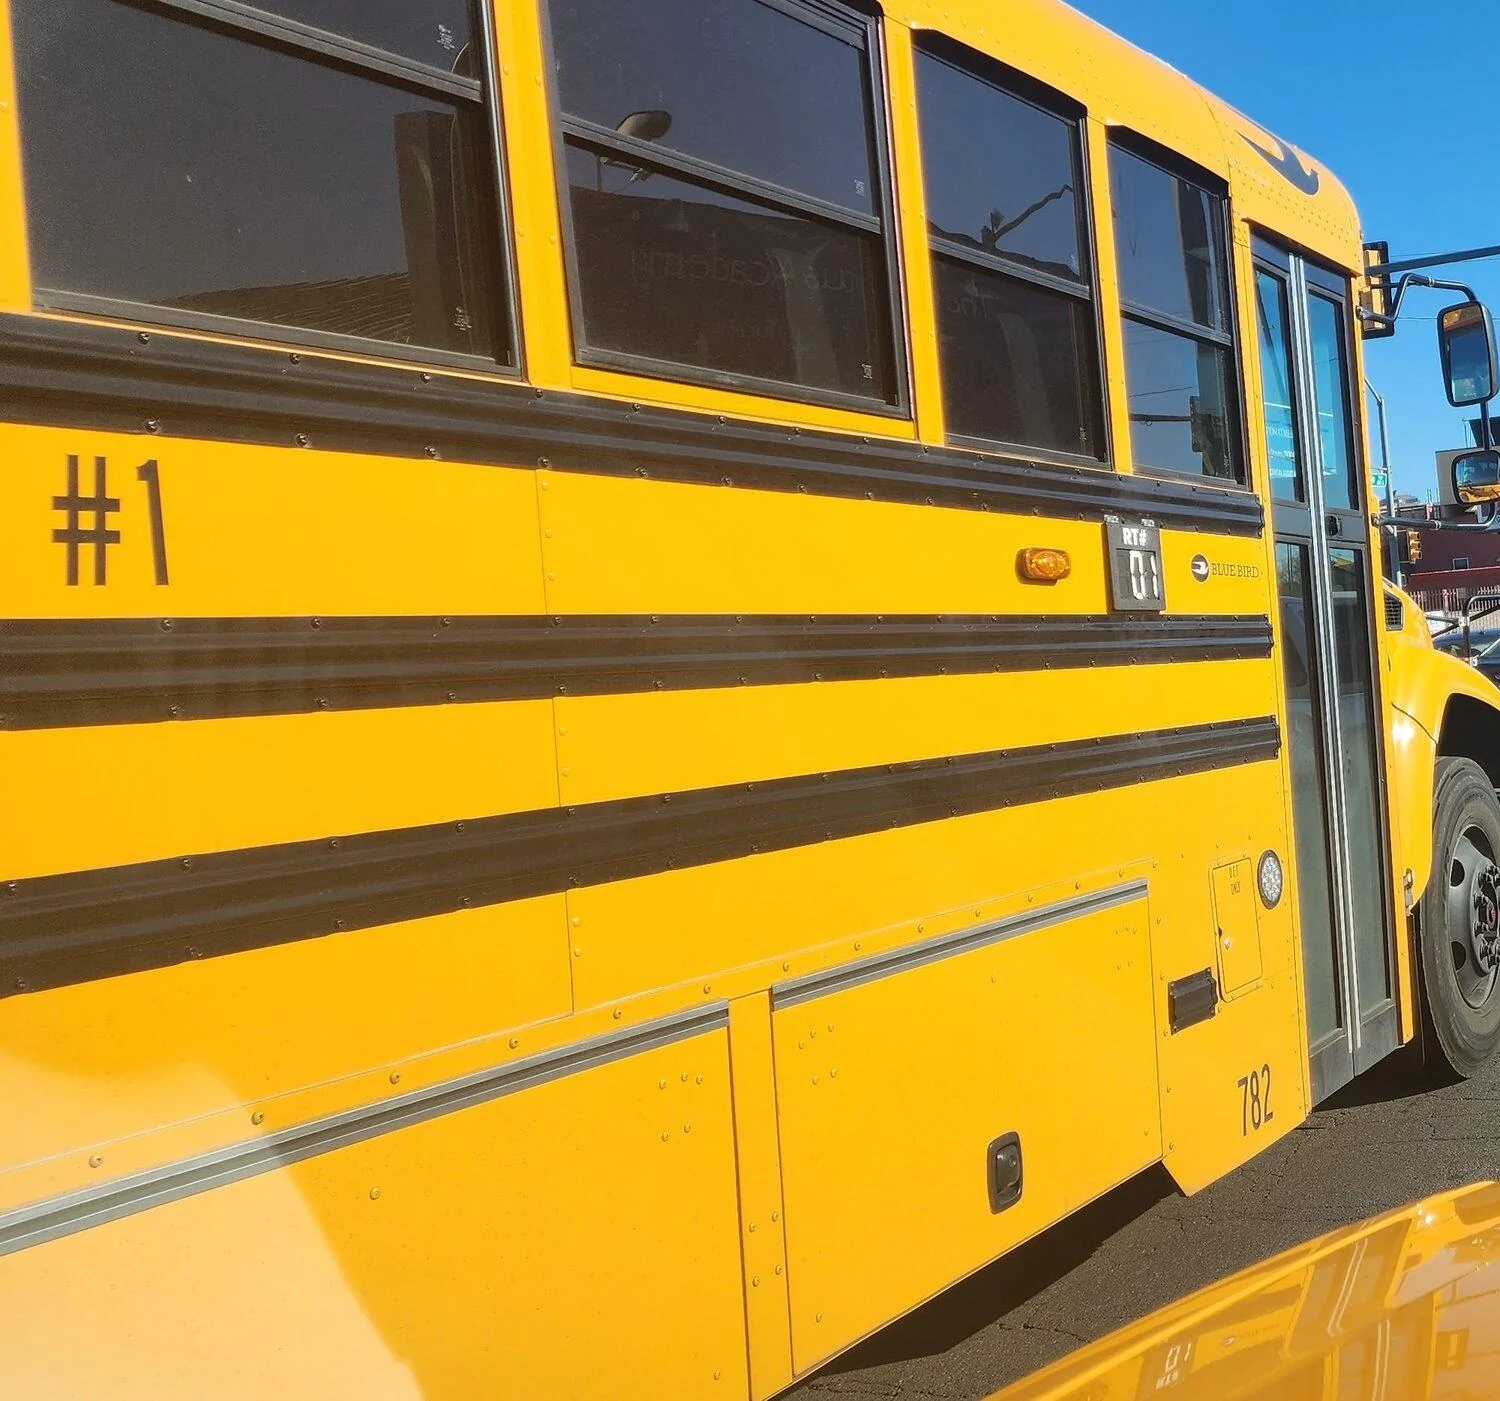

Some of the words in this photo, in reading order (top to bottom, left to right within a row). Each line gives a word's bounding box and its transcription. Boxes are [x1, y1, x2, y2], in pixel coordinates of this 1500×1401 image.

[52, 454, 169, 586] #1
[1122, 527, 1147, 546] RT#
[1129, 550, 1159, 600] 01
[1211, 562, 1237, 576] BLUE
[1238, 565, 1259, 578] BIRD
[1237, 1063, 1273, 1137] 782
